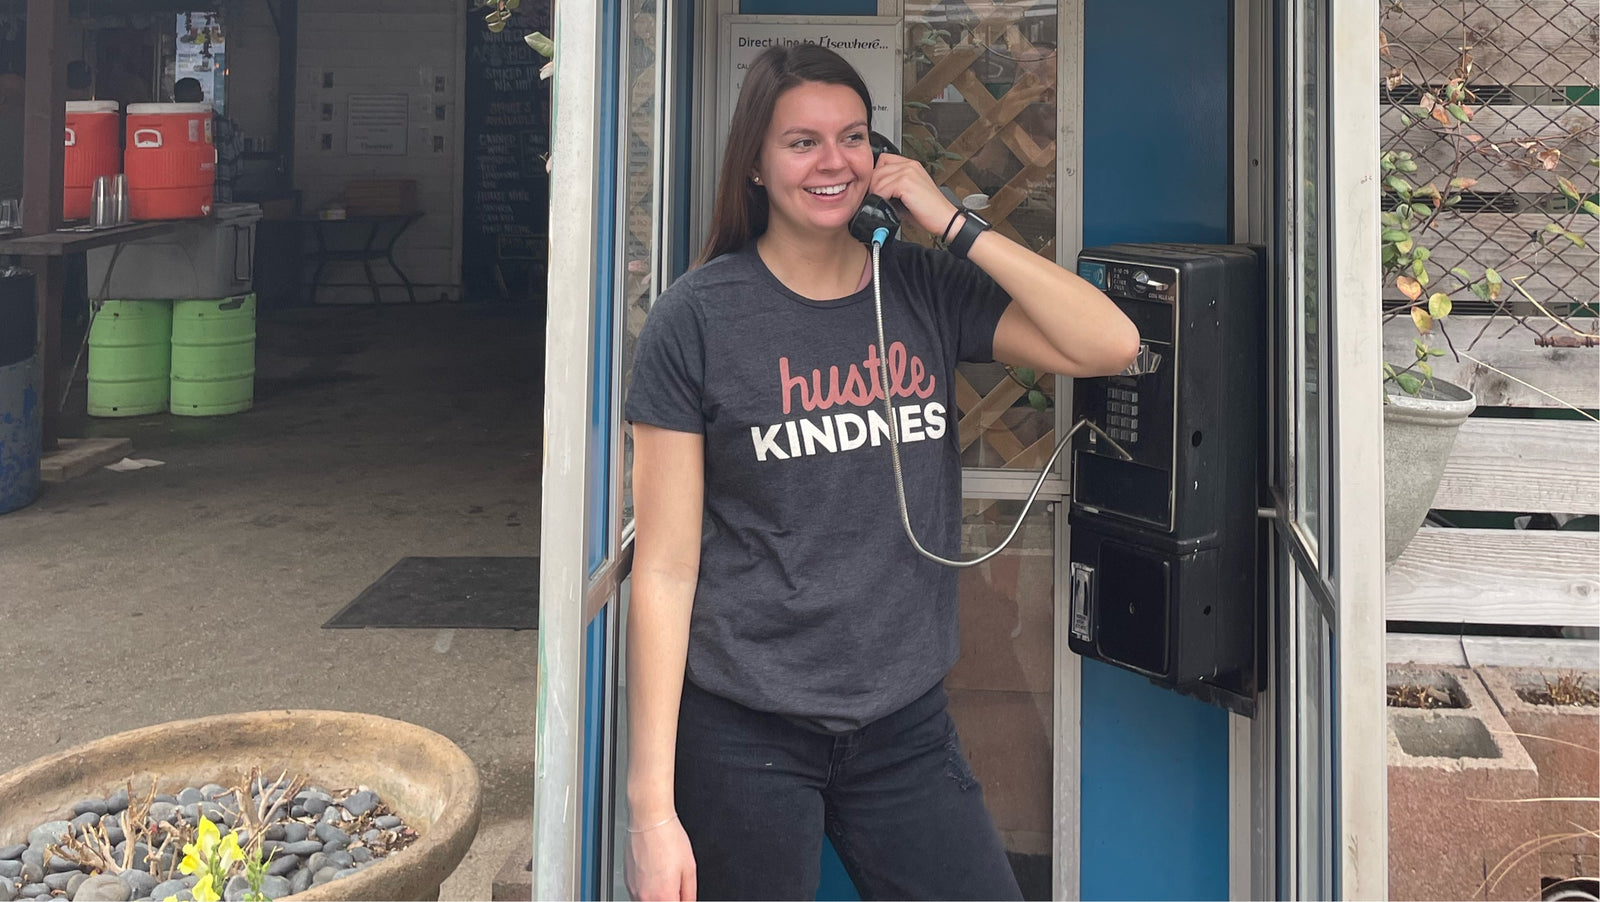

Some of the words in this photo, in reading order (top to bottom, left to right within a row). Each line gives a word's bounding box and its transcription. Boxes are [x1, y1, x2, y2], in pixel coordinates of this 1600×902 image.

[739, 37, 773, 47] Direct
[776, 37, 800, 47] Line
[803, 37, 815, 45] to
[779, 341, 936, 415] hustle
